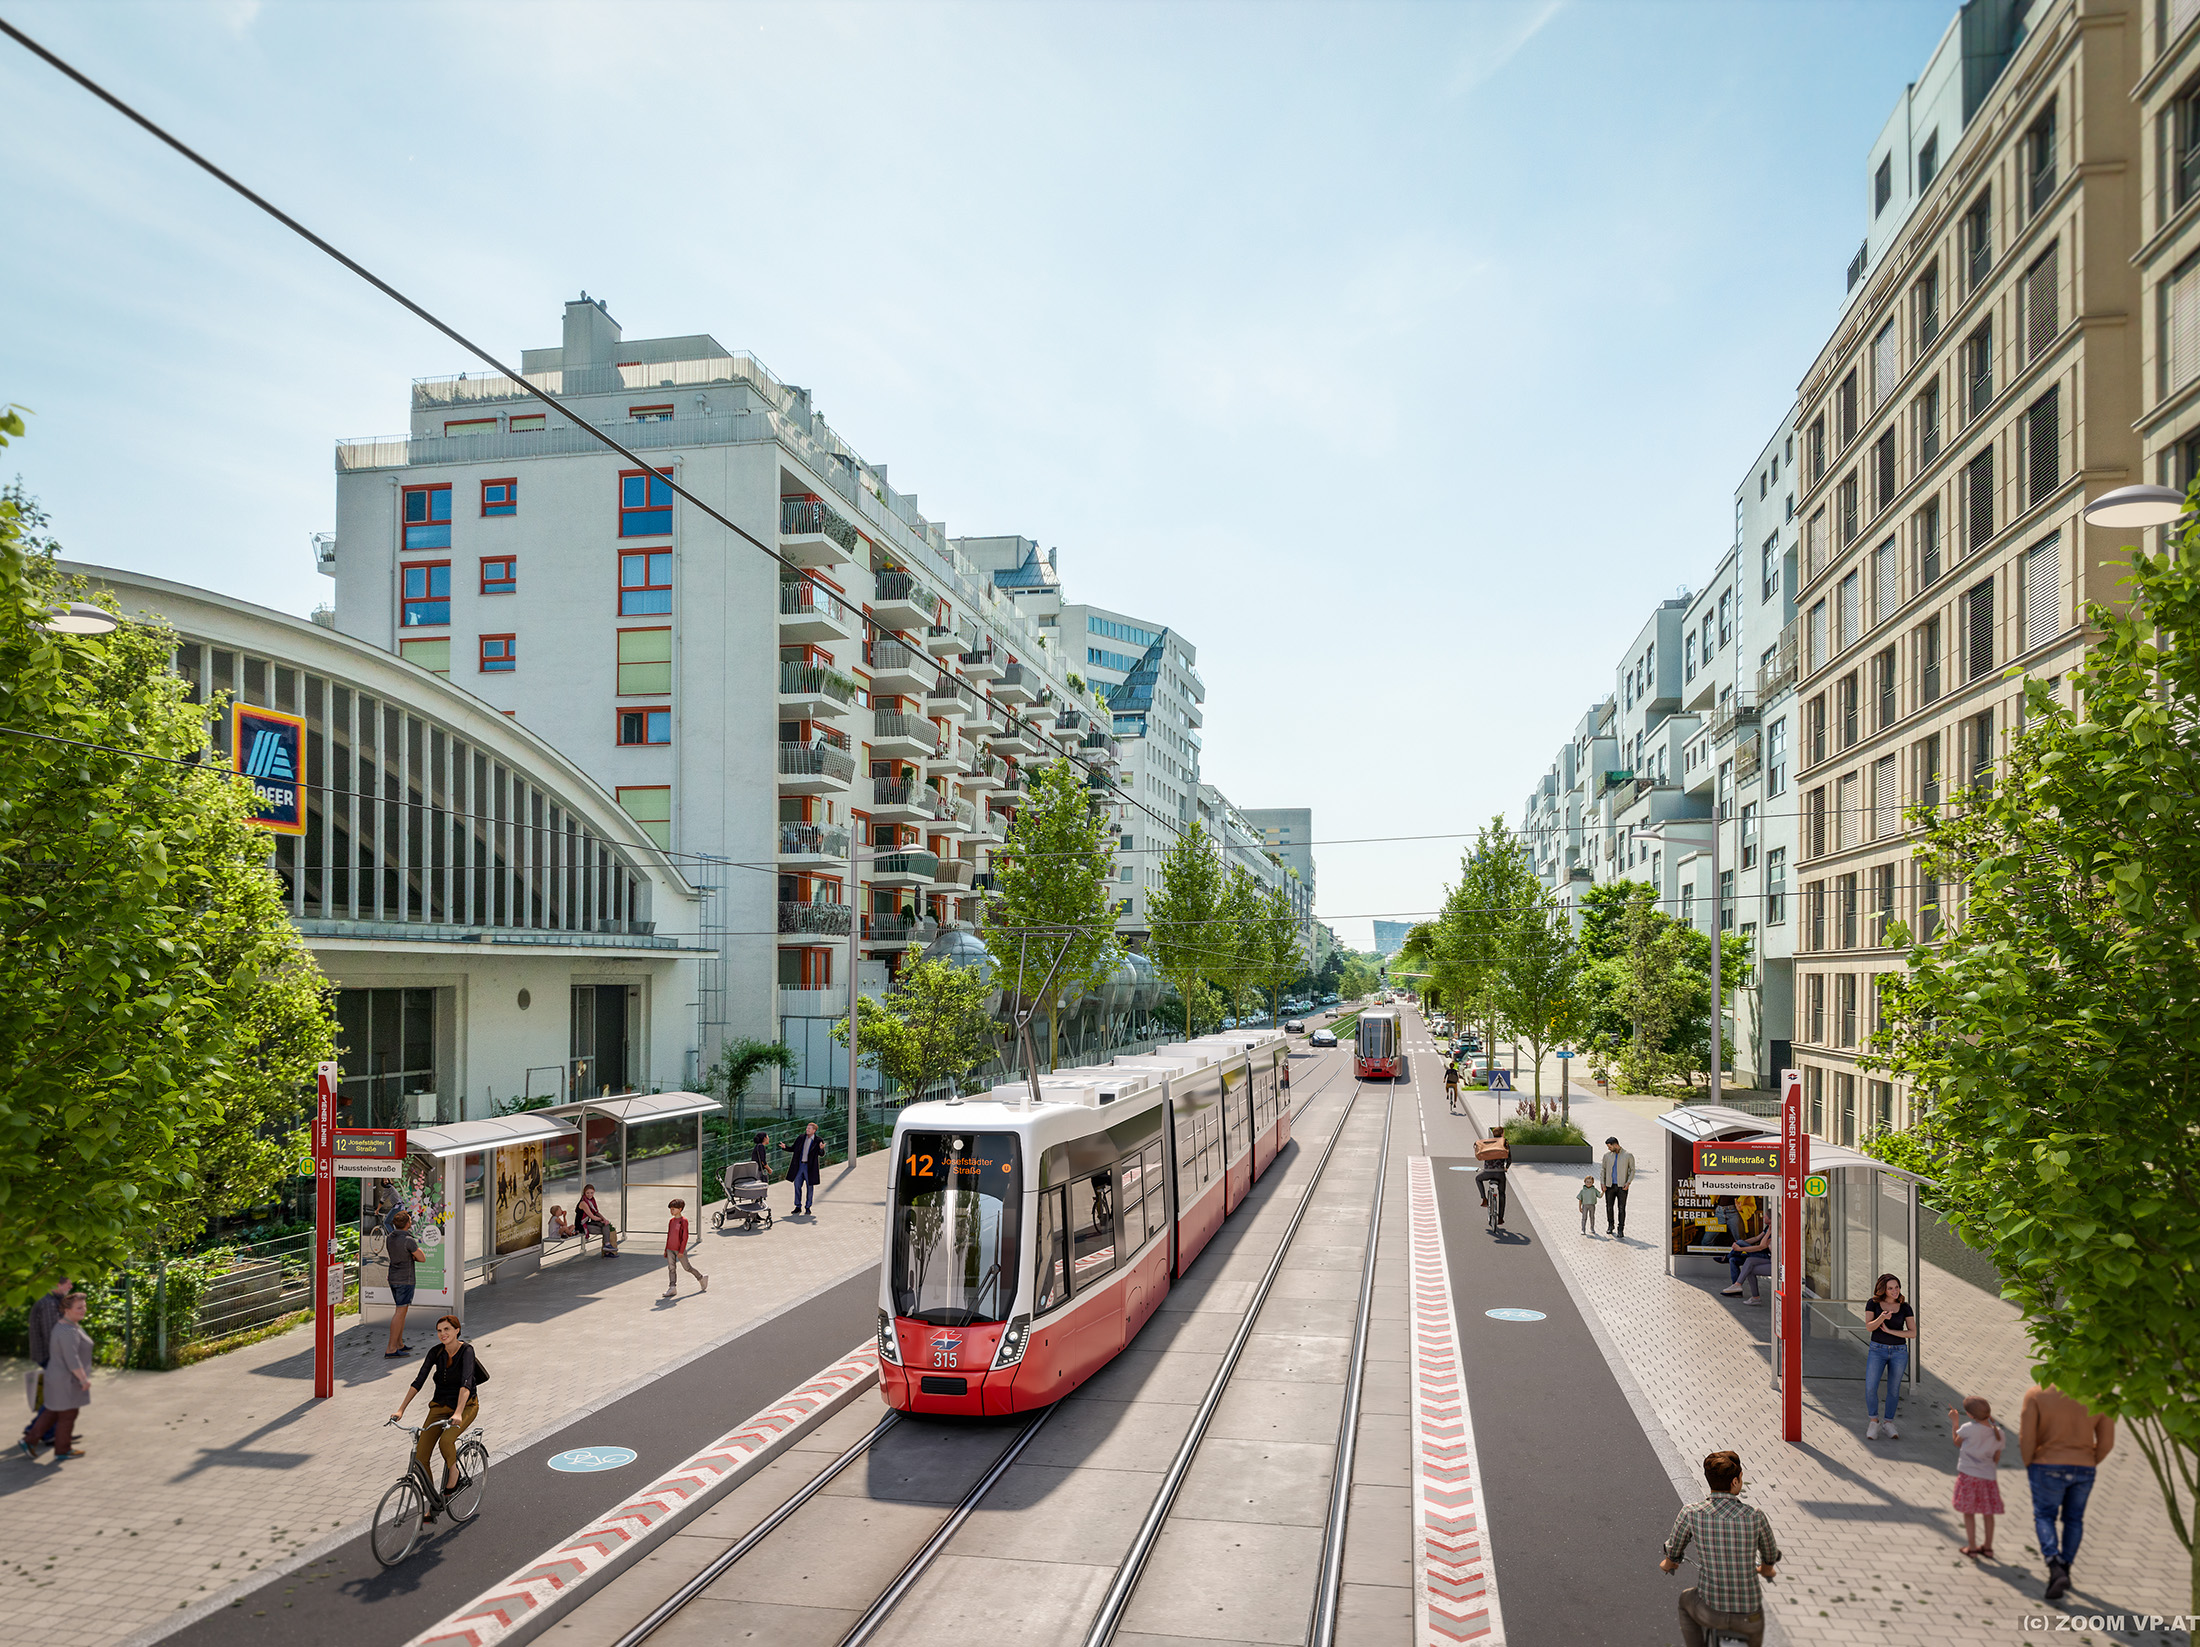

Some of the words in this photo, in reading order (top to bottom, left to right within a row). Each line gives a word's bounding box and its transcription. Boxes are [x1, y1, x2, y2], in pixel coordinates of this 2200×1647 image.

[336, 1139, 347, 1151] 12
[388, 1140, 392, 1152] 1
[941, 1157, 993, 1166] Josefstädter
[1701, 1153, 1717, 1167] 12
[1721, 1155, 1765, 1164] Hillerstraße
[1769, 1154, 1777, 1168] 5
[338, 1164, 397, 1172] Haussteinstraße
[906, 1154, 934, 1177] 12
[952, 1166, 981, 1175] Straße
[1702, 1181, 1776, 1190] Haussteinstraße
[1678, 1189, 1696, 1198] WIE
[1678, 1211, 1708, 1220] LEBEN
[933, 1351, 958, 1368] 315
